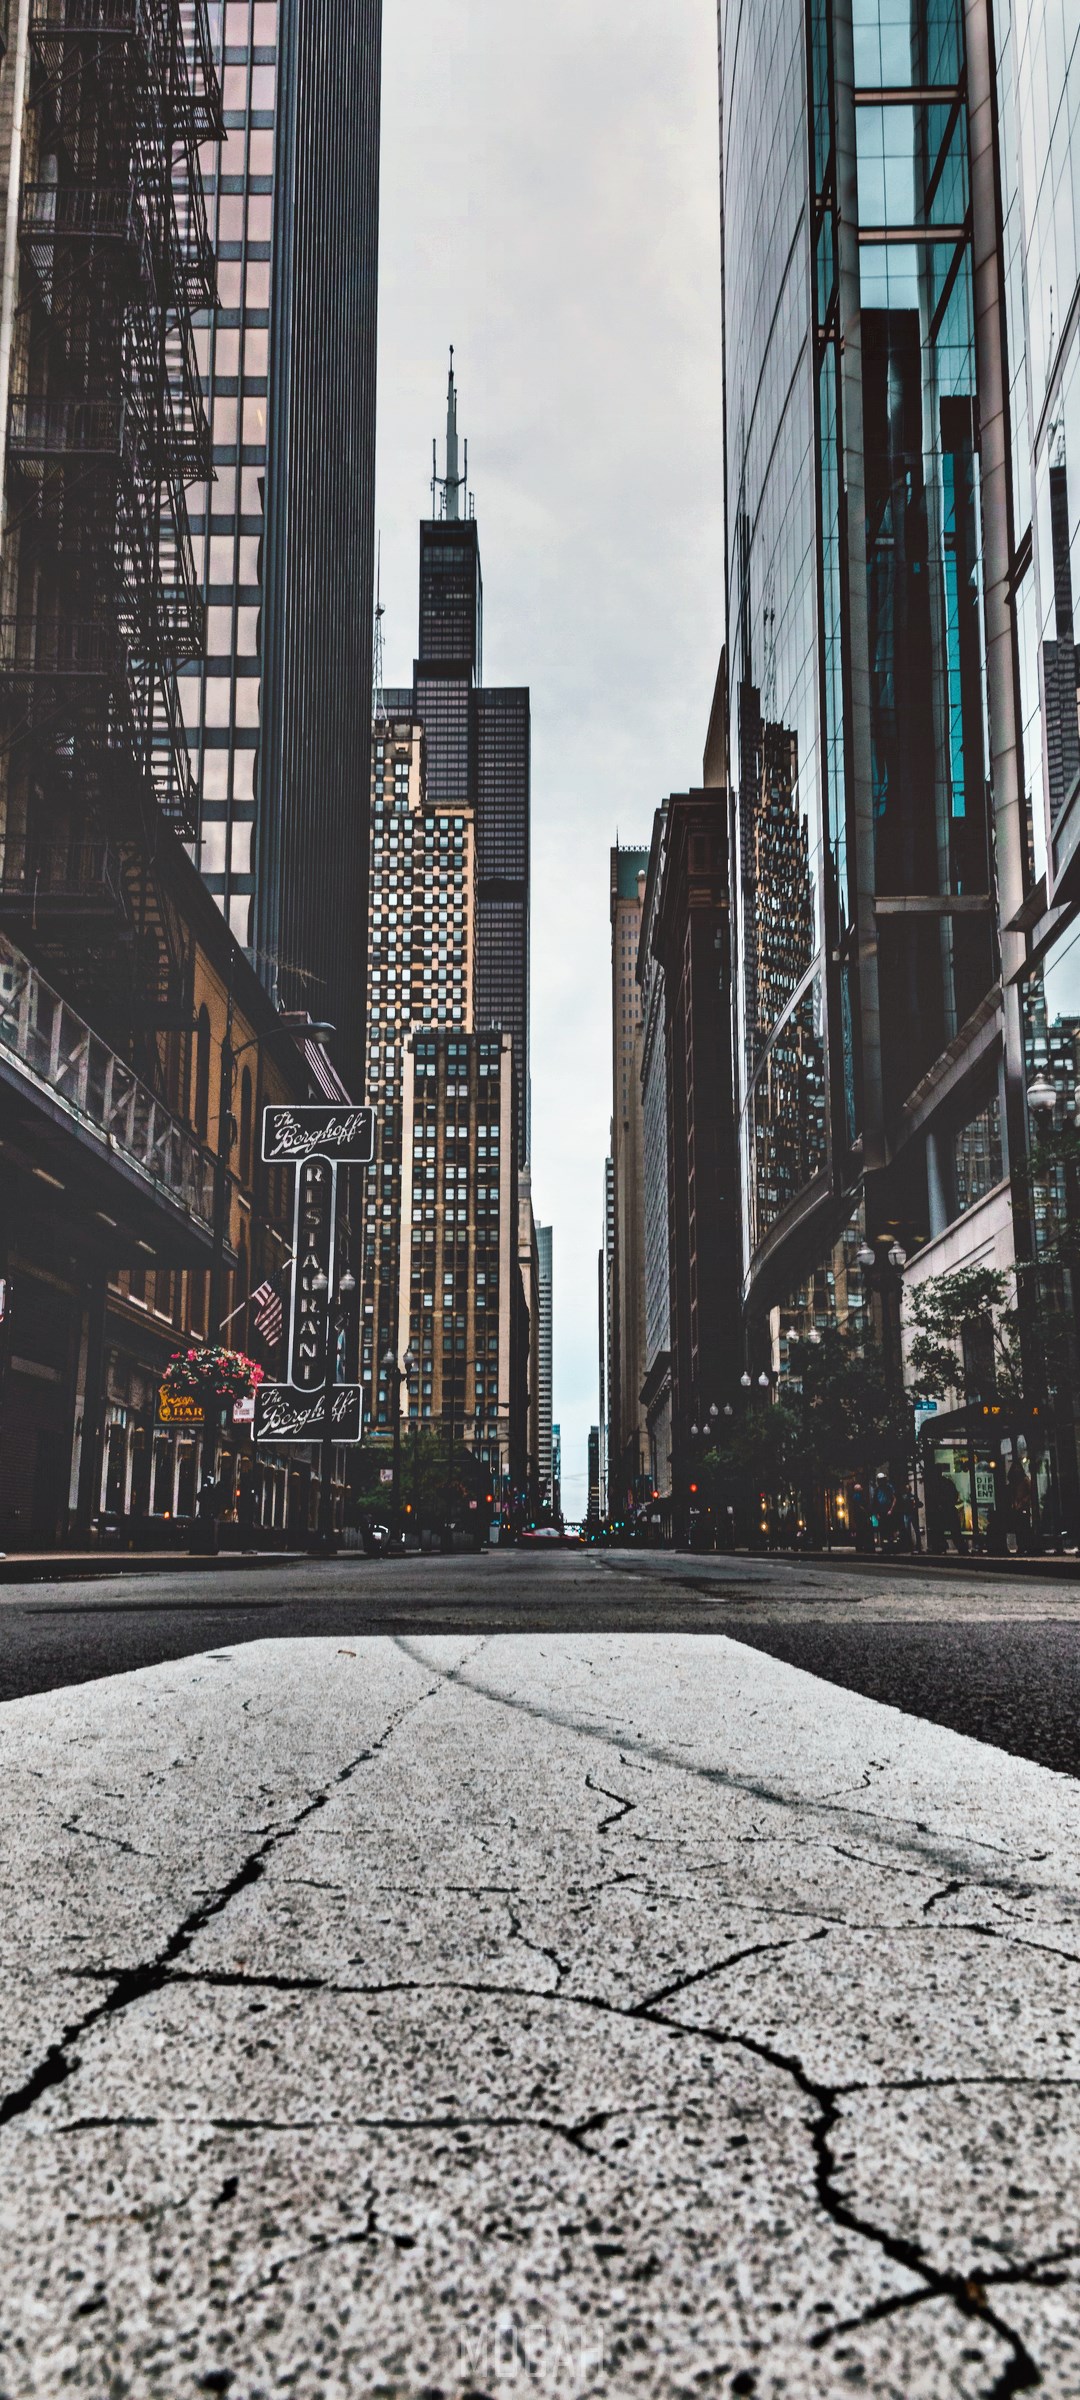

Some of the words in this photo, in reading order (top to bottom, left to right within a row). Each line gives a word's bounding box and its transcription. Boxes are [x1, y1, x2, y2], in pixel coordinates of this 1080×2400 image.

[273, 1111, 295, 1128] The
[260, 1388, 282, 1406] The
[174, 1407, 203, 1416] BAR
